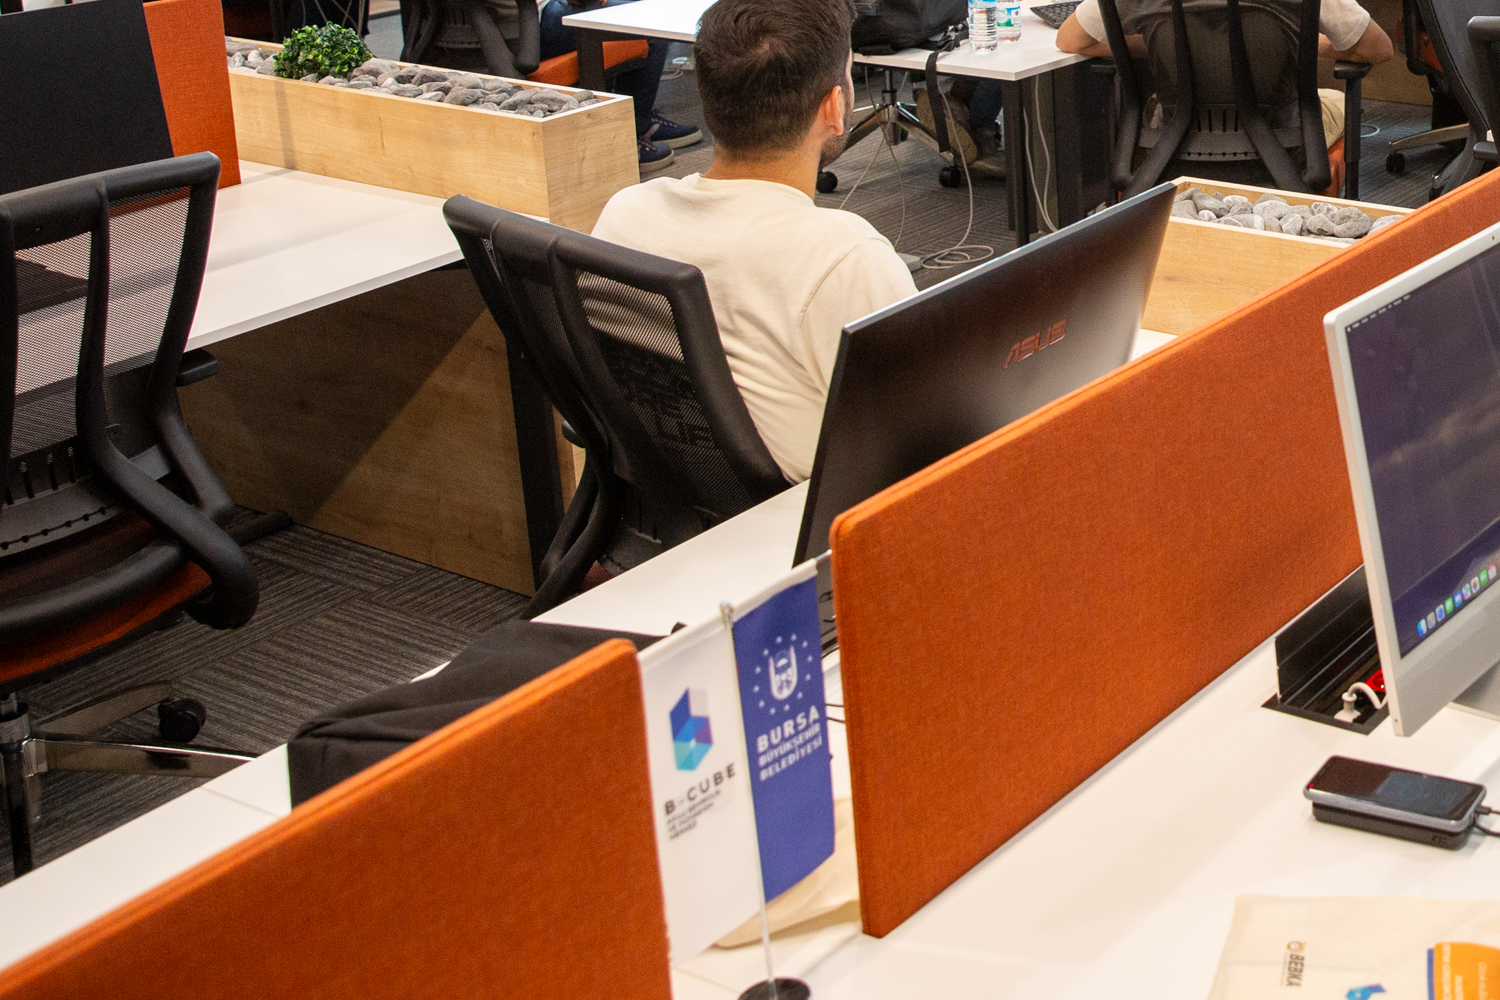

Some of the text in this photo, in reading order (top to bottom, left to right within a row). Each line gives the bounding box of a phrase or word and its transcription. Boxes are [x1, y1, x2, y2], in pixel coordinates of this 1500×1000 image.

[1003, 319, 1067, 368] ASUS
[756, 705, 820, 754] BURSA
[1286, 954, 1305, 987] BEBKA
